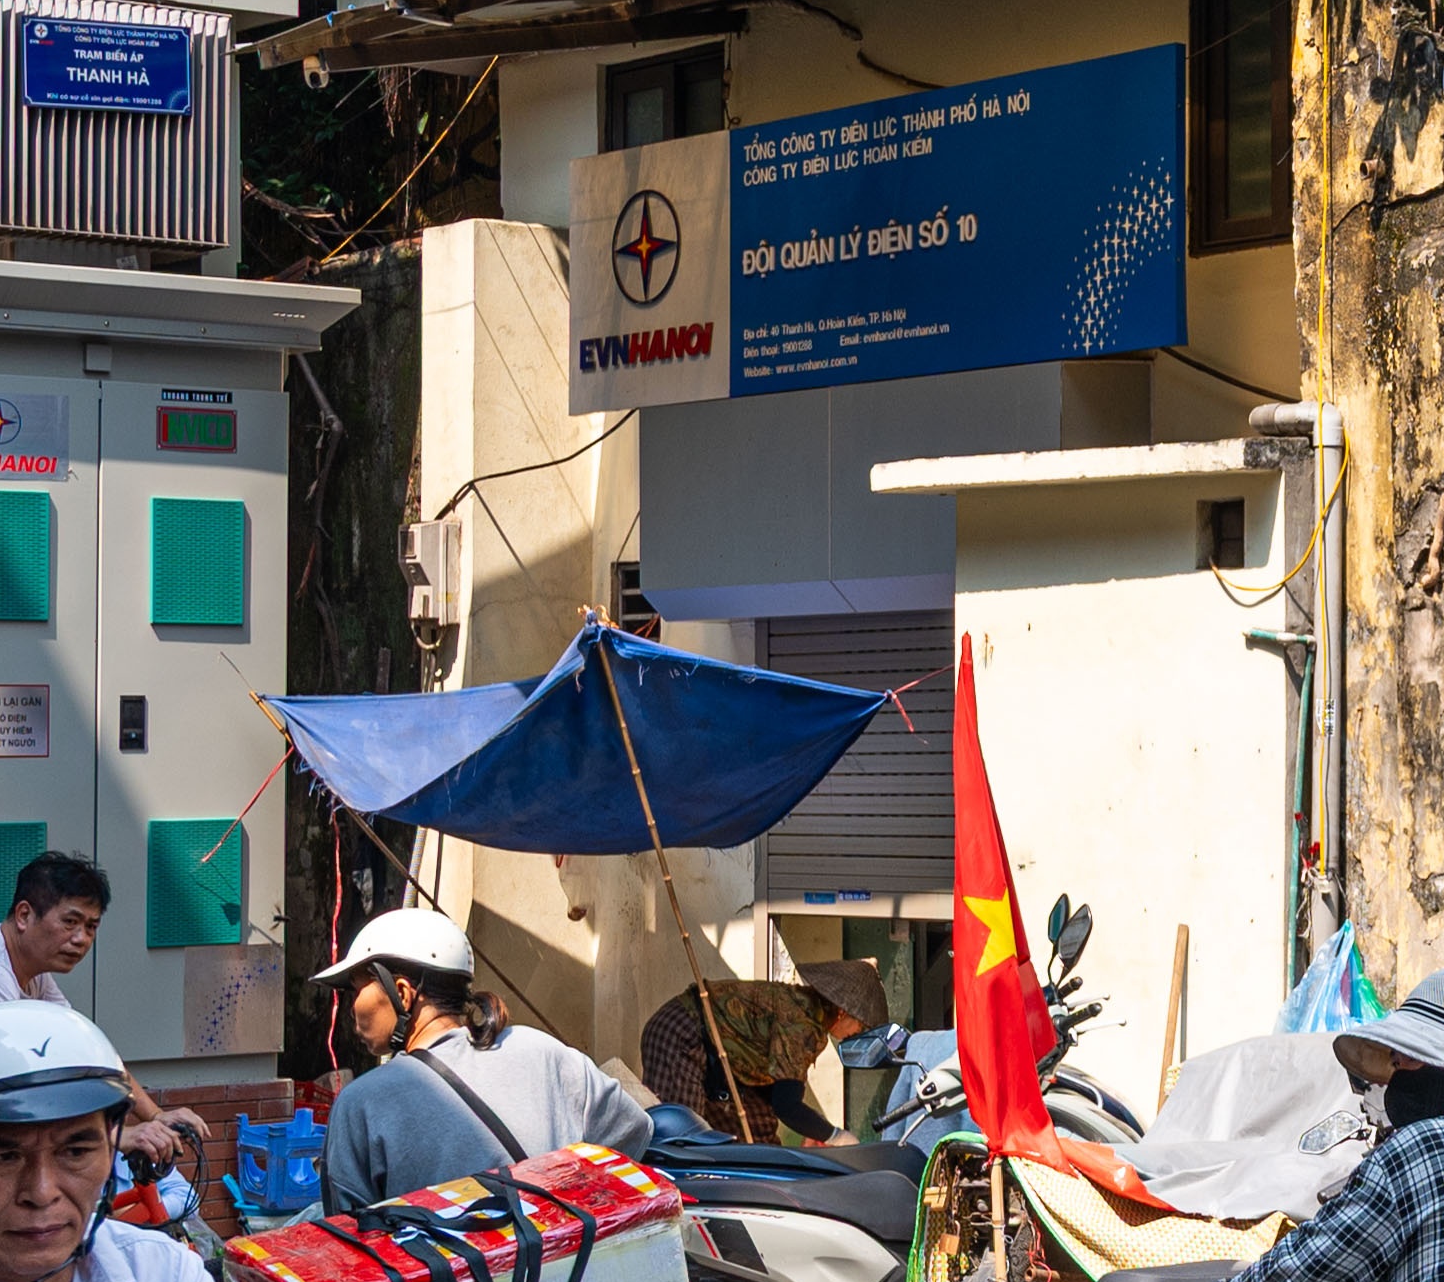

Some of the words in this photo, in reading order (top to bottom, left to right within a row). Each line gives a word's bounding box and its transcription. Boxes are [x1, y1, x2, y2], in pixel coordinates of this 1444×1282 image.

[74, 49, 102, 62] TRẠM
[105, 49, 128, 62] BIẾN
[129, 50, 144, 63] ÁP
[66, 67, 122, 84] THANH
[127, 67, 150, 86] HÀ
[744, 132, 776, 163] TỔNG
[781, 131, 815, 156] CÔNG
[820, 130, 836, 149] TY
[841, 120, 868, 146] ĐIỆN
[873, 116, 897, 138] LỰC
[903, 107, 945, 133] THÀNH
[950, 93, 977, 125] PHỐ
[983, 94, 1002, 119] HÀ
[1008, 88, 1030, 117] NỘI
[743, 164, 777, 187] CÔNG
[782, 161, 798, 179] TY
[802, 154, 829, 177] ĐIỆN
[834, 149, 859, 173] LỰC
[902, 132, 933, 158] KIẾM
[742, 239, 776, 278] ĐỘI
[780, 228, 834, 269] QUẢN
[840, 225, 862, 261] LÝ
[867, 219, 913, 259] ĐIỆN
[918, 205, 950, 248] SỐ
[956, 214, 978, 242] 10
[782, 323, 804, 335] Thanh
[579, 321, 714, 374] EVNHANOI
[840, 334, 862, 347] Email:
[3, 696, 19, 709] LẠI
